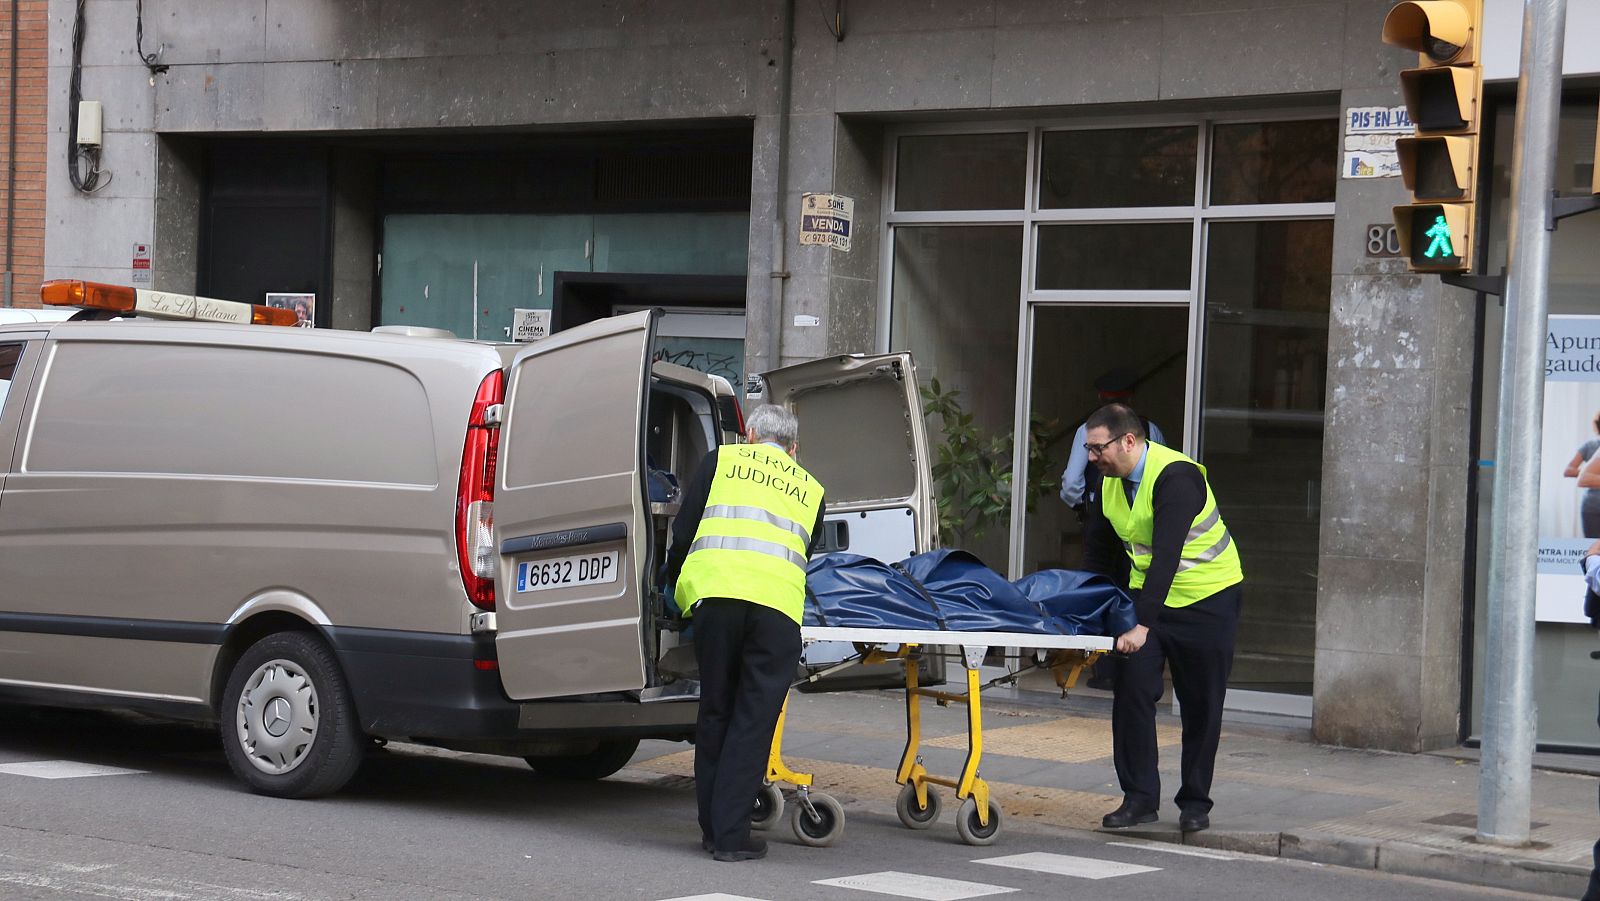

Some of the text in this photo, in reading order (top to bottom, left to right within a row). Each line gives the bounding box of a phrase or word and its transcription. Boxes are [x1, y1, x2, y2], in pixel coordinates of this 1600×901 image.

[1351, 111, 1414, 128] PIS EN VE
[811, 217, 844, 233] VENDA
[812, 234, 826, 244] 973
[1368, 226, 1401, 254] 80
[151, 293, 169, 312] La
[518, 325, 544, 333] CINEMA
[1547, 332, 1600, 353] Apun
[738, 447, 808, 482] SERVEI
[725, 464, 809, 508] JUDICIAL
[530, 555, 612, 587] 6632 DDP
